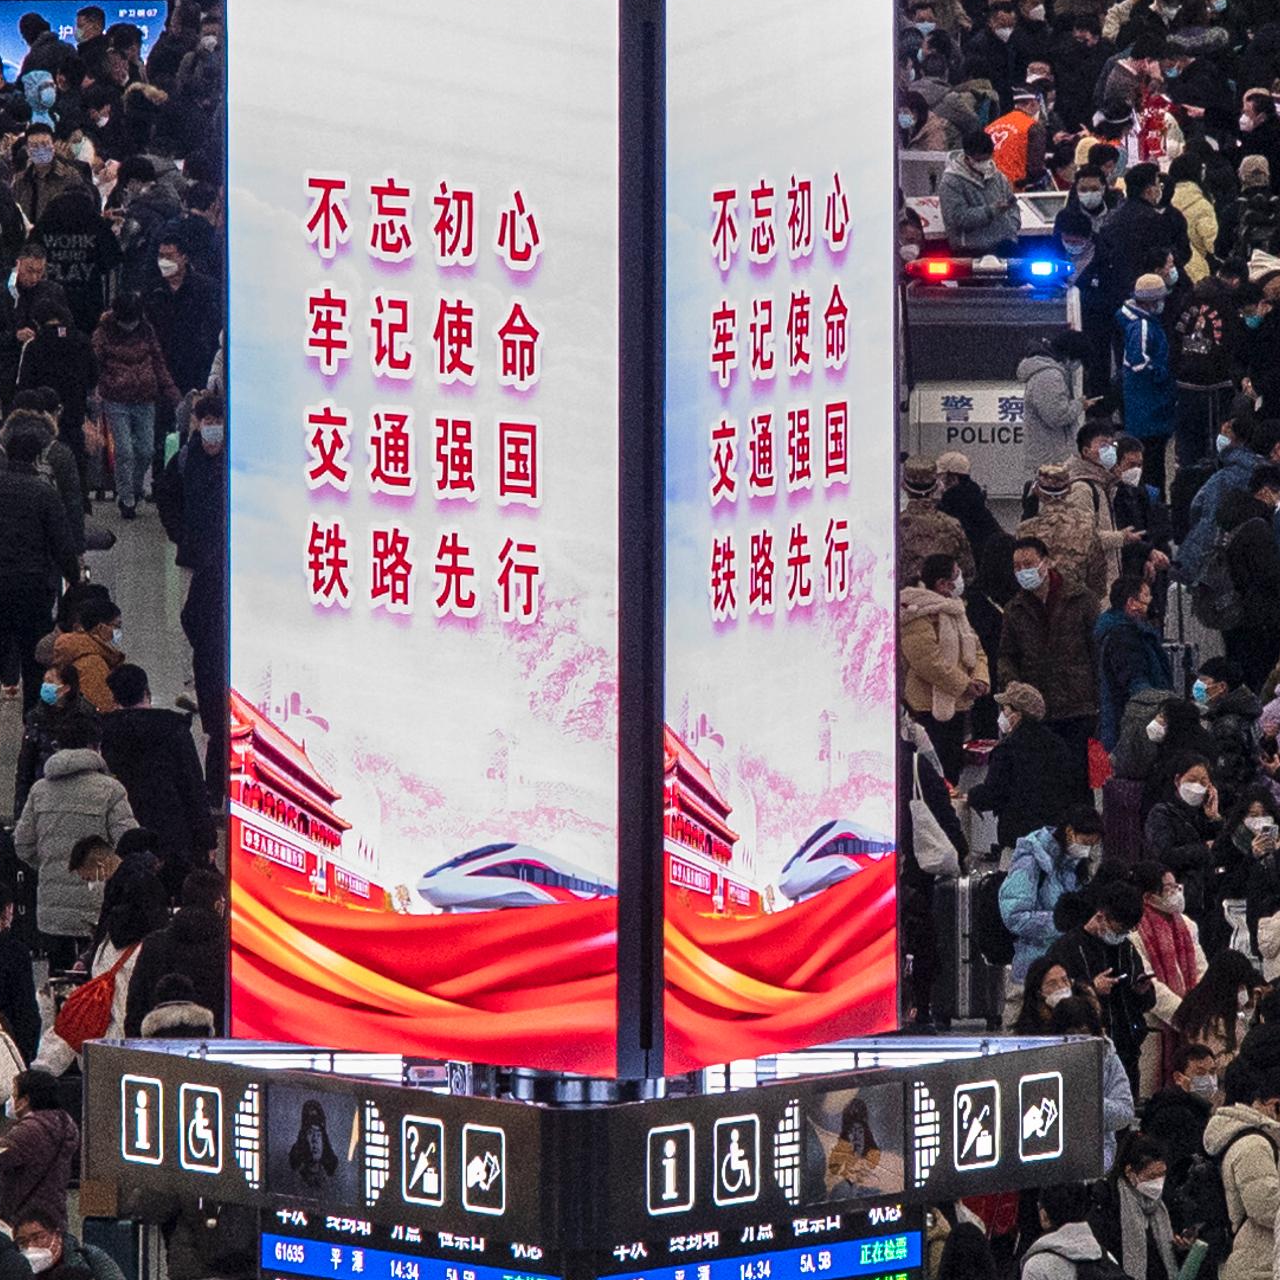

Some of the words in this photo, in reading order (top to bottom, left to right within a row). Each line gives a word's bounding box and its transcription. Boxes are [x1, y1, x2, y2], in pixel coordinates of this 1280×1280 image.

[43, 234, 97, 247] WORK
[306, 177, 540, 262] 不忘初心
[712, 172, 850, 261] 不忘初心
[46, 263, 95, 281] PLAY
[307, 288, 540, 382] 牢记使命
[712, 284, 849, 379] 牢记使命
[711, 400, 849, 498] 交通强国
[940, 395, 1026, 422] 警察
[946, 426, 1024, 445] POLICE
[307, 407, 539, 499] 交通强国
[306, 521, 541, 617] 铁路先行
[711, 517, 849, 616] 铁路先行
[275, 1242, 305, 1263] G1635
[390, 1261, 419, 1280] 14:34
[860, 1237, 907, 1265] 正在检票
